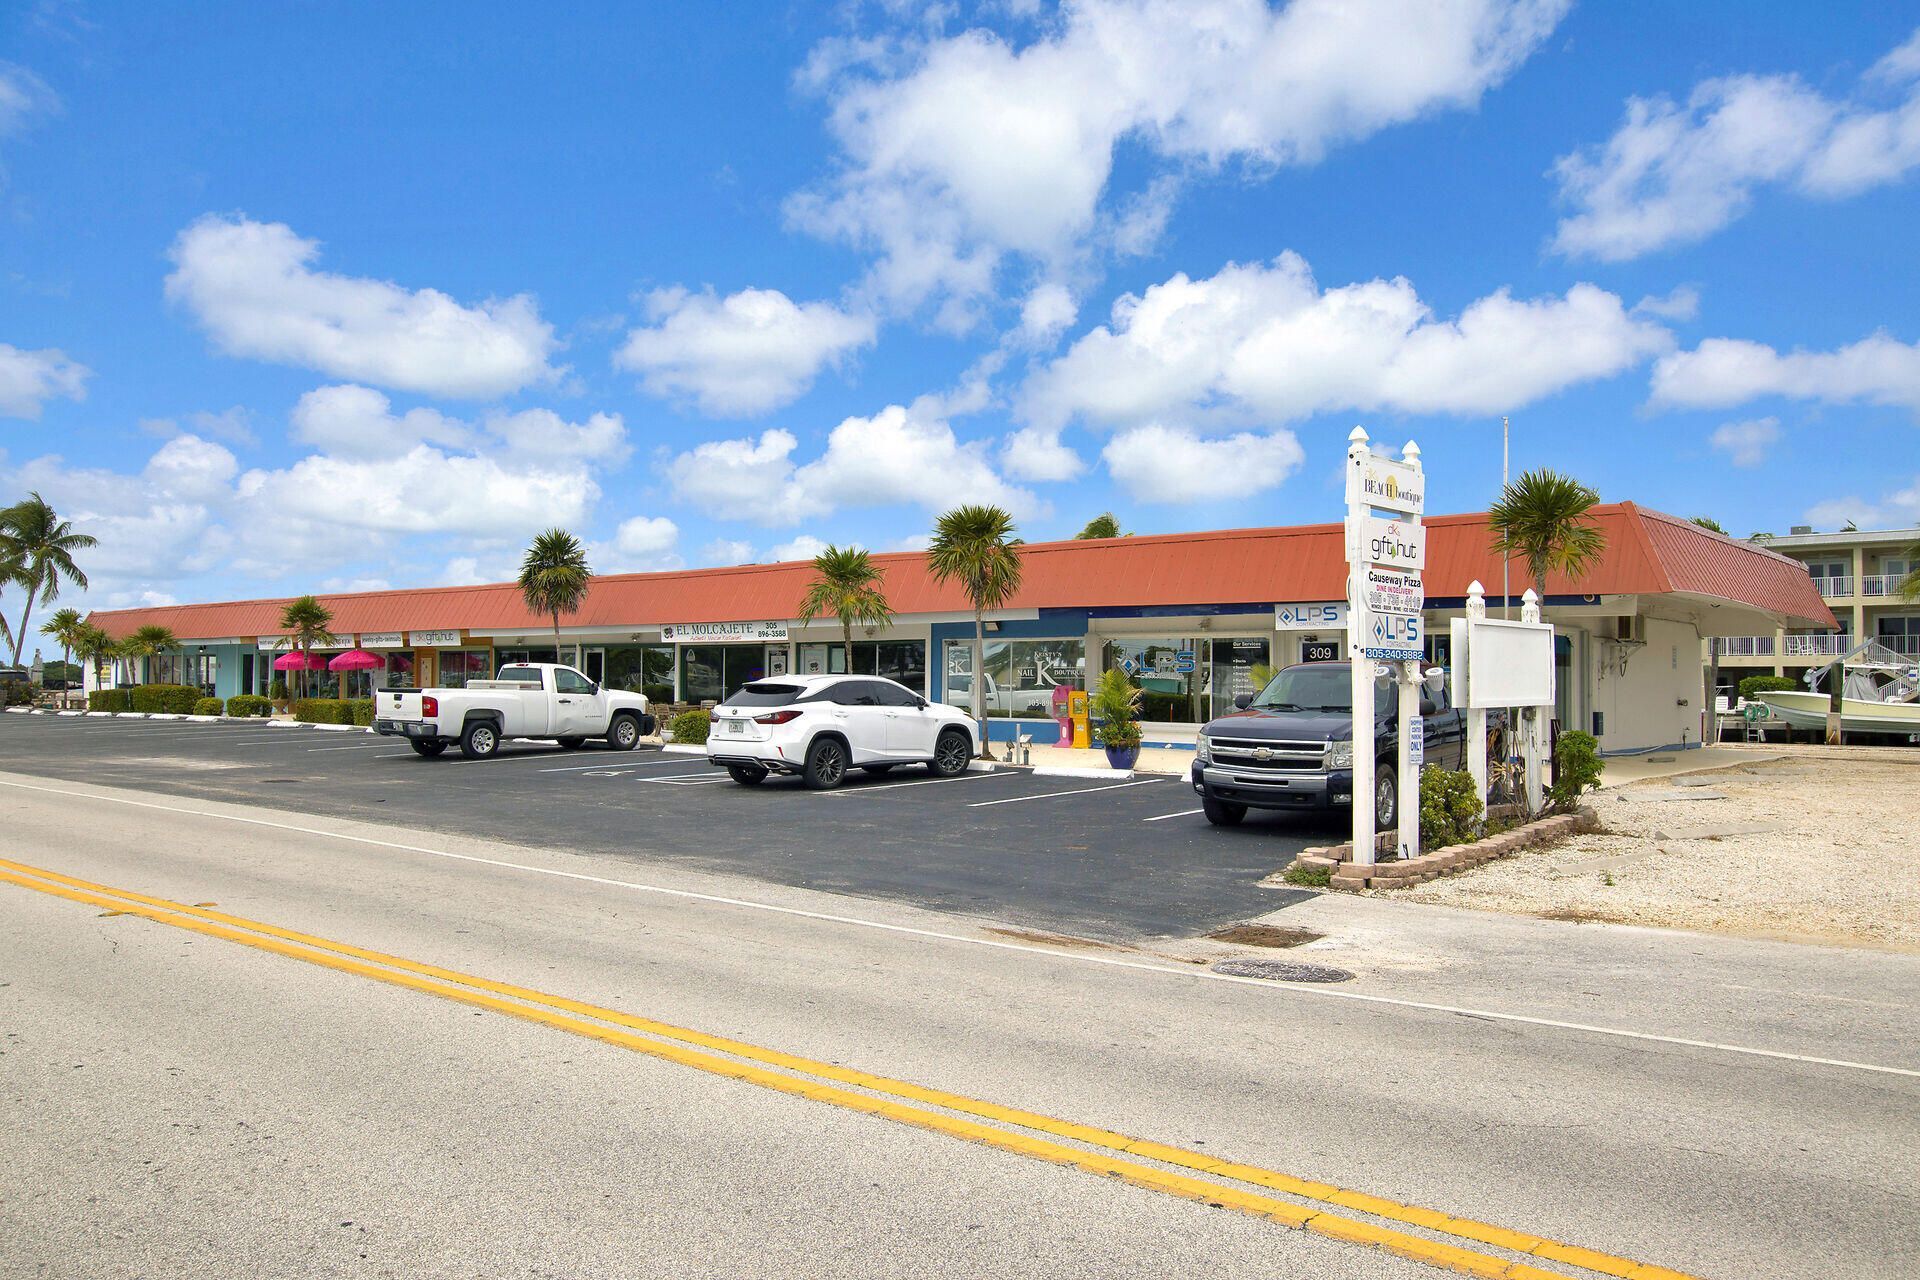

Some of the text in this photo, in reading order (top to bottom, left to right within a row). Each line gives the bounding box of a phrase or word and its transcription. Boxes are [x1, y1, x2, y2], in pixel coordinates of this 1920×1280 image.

[1365, 480, 1422, 506] BEACH boutique
[1372, 536, 1417, 560] gift hut
[1369, 571, 1421, 588] Causeway Pizza
[1377, 585, 1387, 593] DINE
[1296, 607, 1338, 622] LPS
[677, 624, 753, 636] EL MOLCAJETE
[758, 630, 787, 638] 896-3588
[1387, 616, 1418, 641] LPS
[441, 632, 454, 641] hut
[1310, 648, 1331, 659] 309
[1141, 652, 1196, 673] LPS
[1017, 669, 1034, 677] NAIL
[1035, 660, 1062, 686] K
[1411, 742, 1422, 751] ONLY
